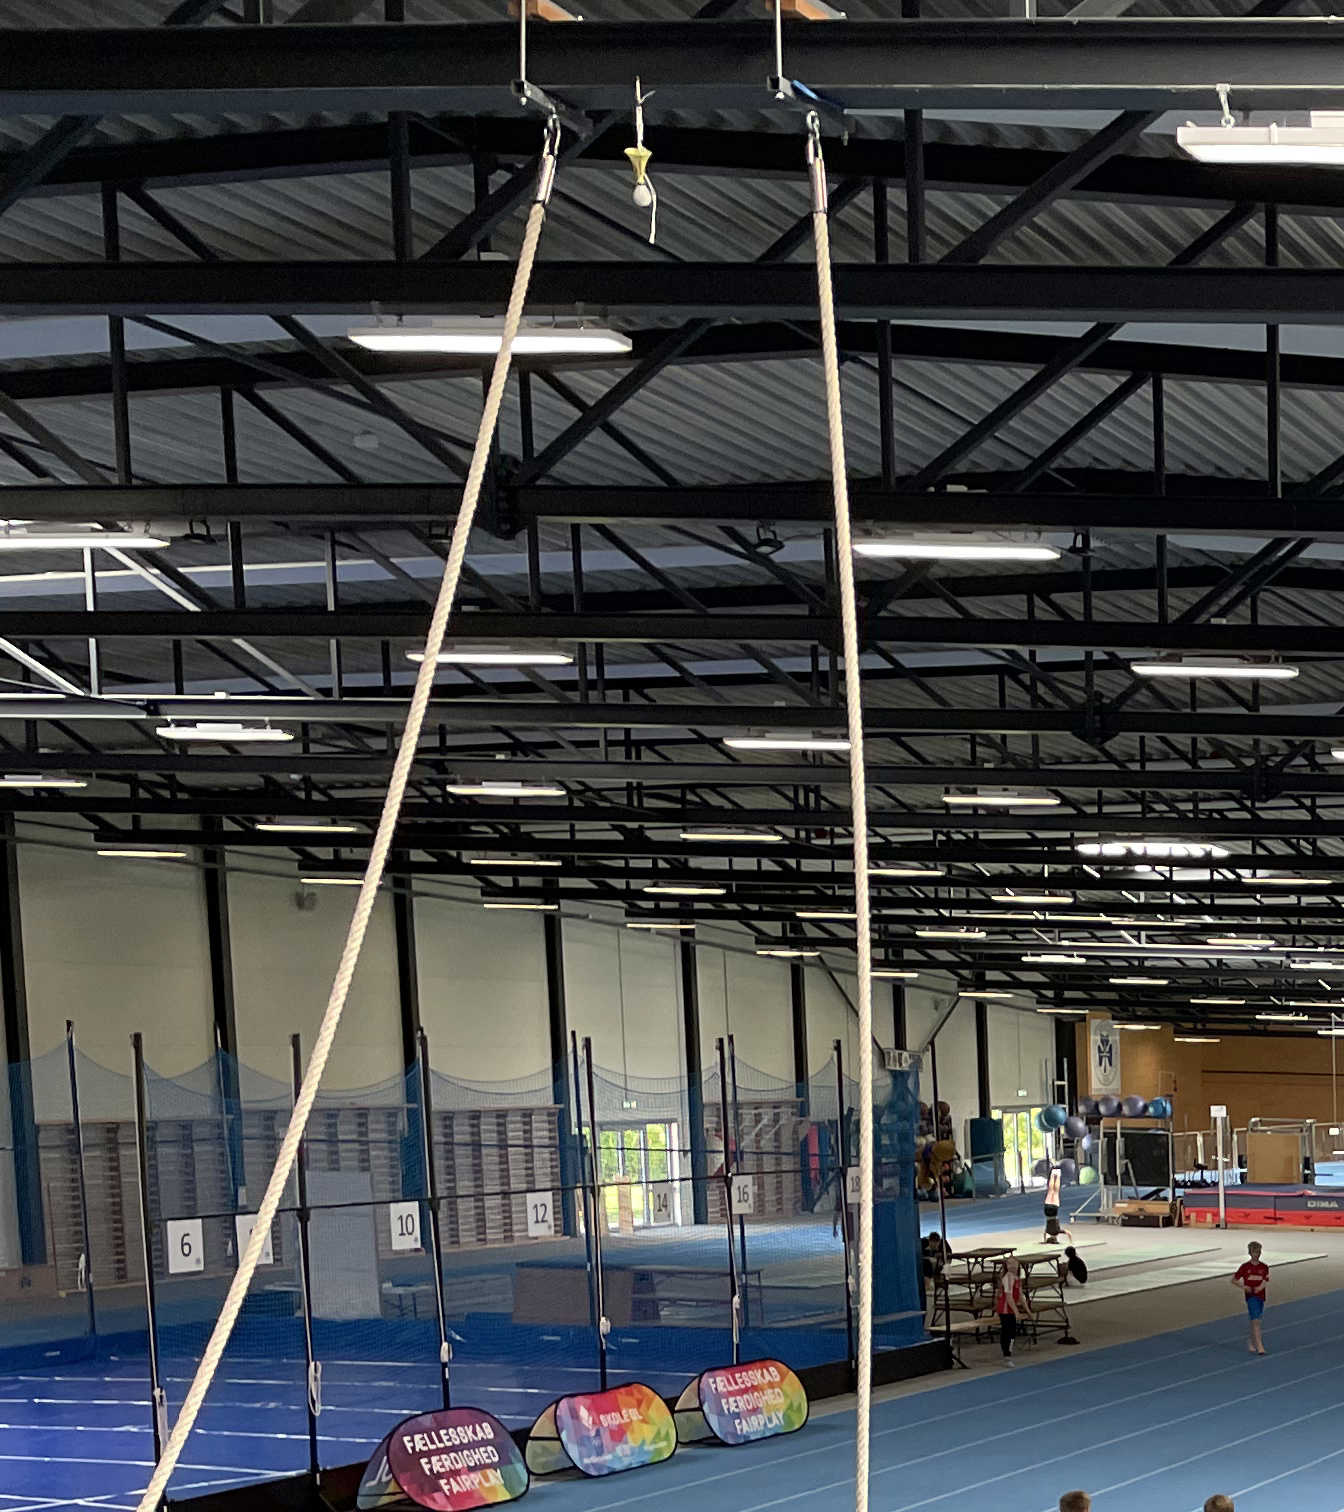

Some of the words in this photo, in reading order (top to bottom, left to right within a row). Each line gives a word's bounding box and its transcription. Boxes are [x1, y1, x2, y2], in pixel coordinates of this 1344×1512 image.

[656, 1192, 669, 1213] 14
[736, 1184, 749, 1203] 16
[1306, 1200, 1340, 1208] DIMA
[397, 1213, 415, 1237] 10
[533, 1203, 549, 1224] 12
[180, 1233, 192, 1257] 6
[709, 1366, 781, 1394] FÆLLESSKAB
[402, 1422, 495, 1455] FÆLLESSKAB
[419, 1445, 500, 1477] FÆRDIGHED
[438, 1468, 505, 1496] FAIRPLAY
